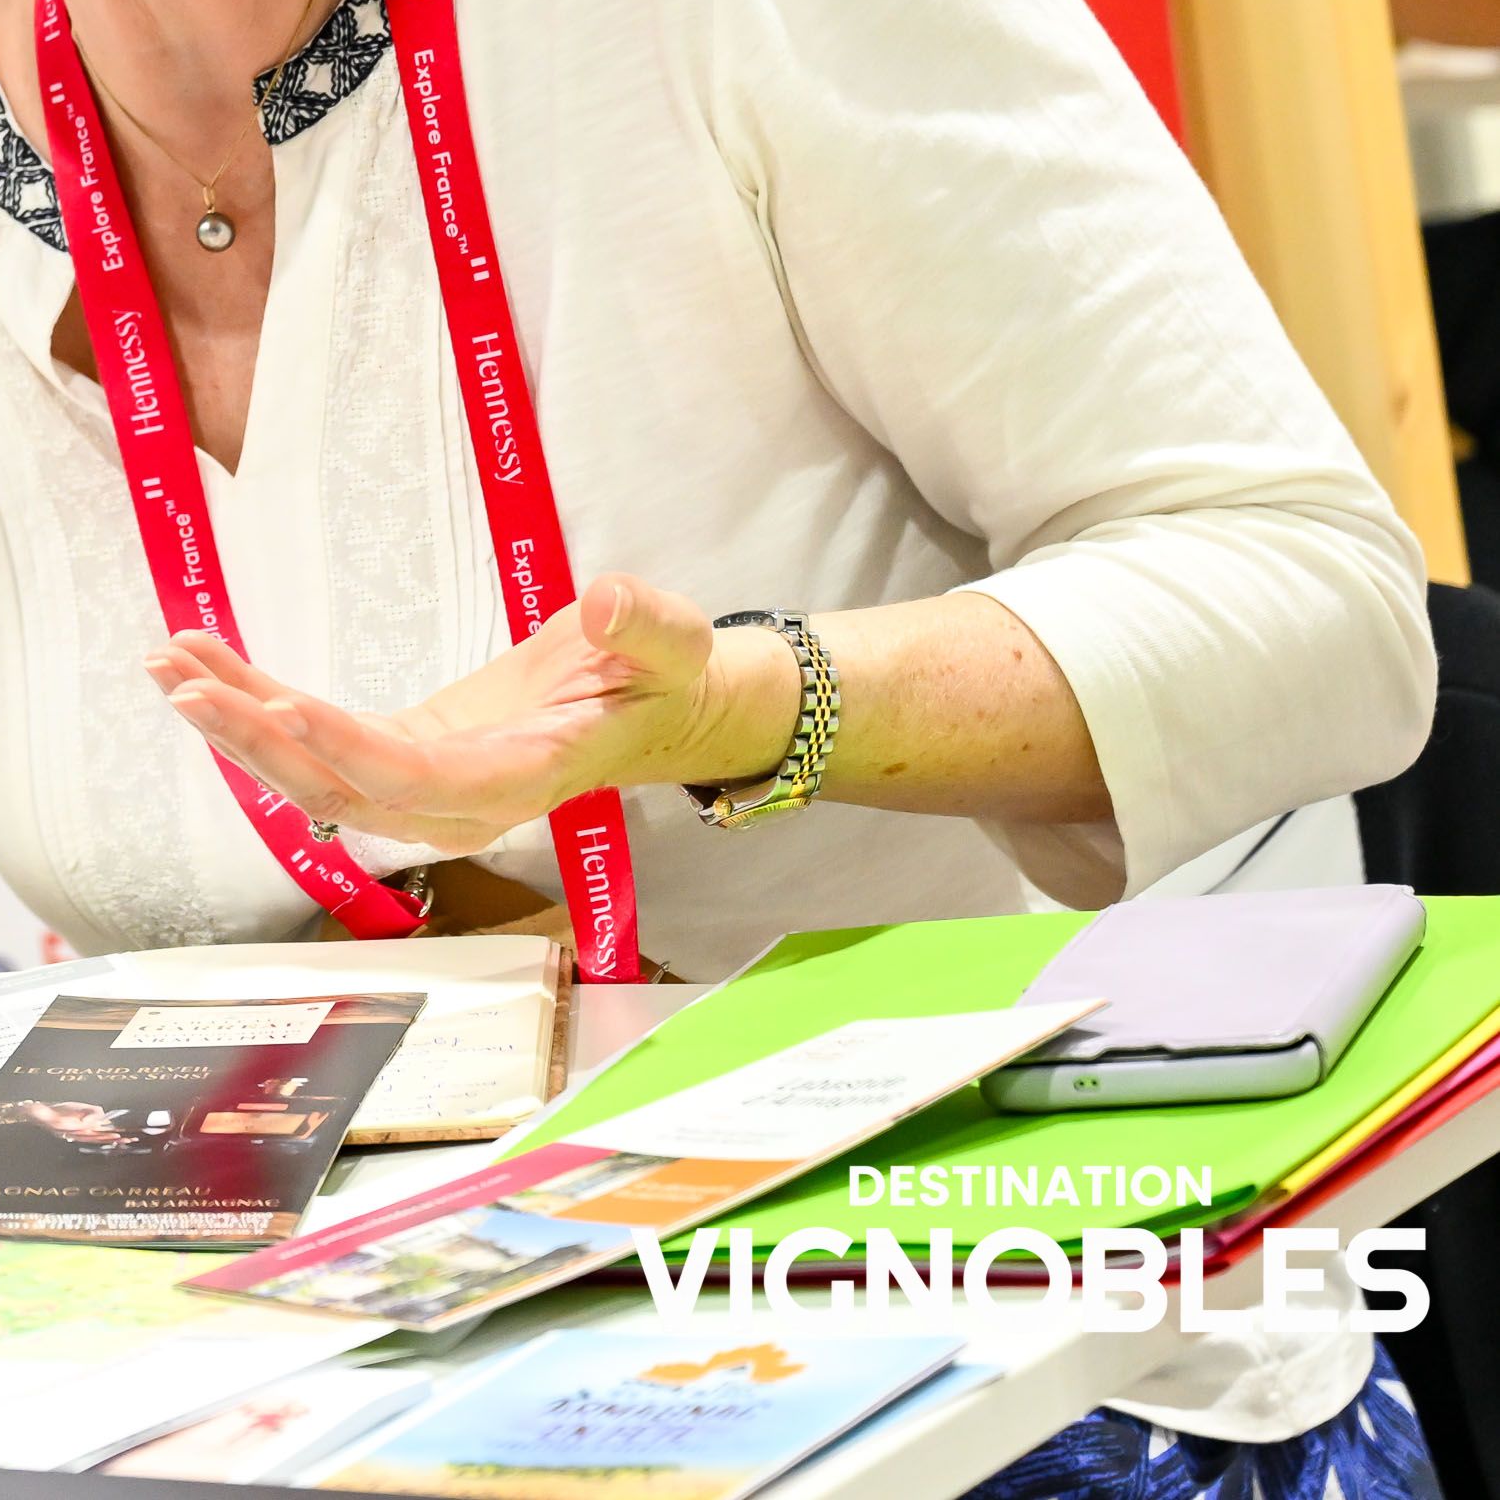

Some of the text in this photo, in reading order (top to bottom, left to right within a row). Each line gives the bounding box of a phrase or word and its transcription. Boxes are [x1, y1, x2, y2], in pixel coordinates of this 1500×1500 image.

[413, 49, 441, 145] Explore
[90, 191, 124, 272] Explore
[112, 309, 164, 436] Hennessy
[472, 332, 524, 484] Hennessy
[511, 538, 543, 635] Explore
[576, 826, 617, 979] Hennessy
[13, 1066, 41, 1075] LE
[46, 1067, 130, 1076] GRAND
[59, 1074, 87, 1082] DE
[98, 1074, 138, 1082] VOS
[89, 1186, 212, 1198] GARREAU
[163, 1198, 281, 1208] ARMAGNAC
